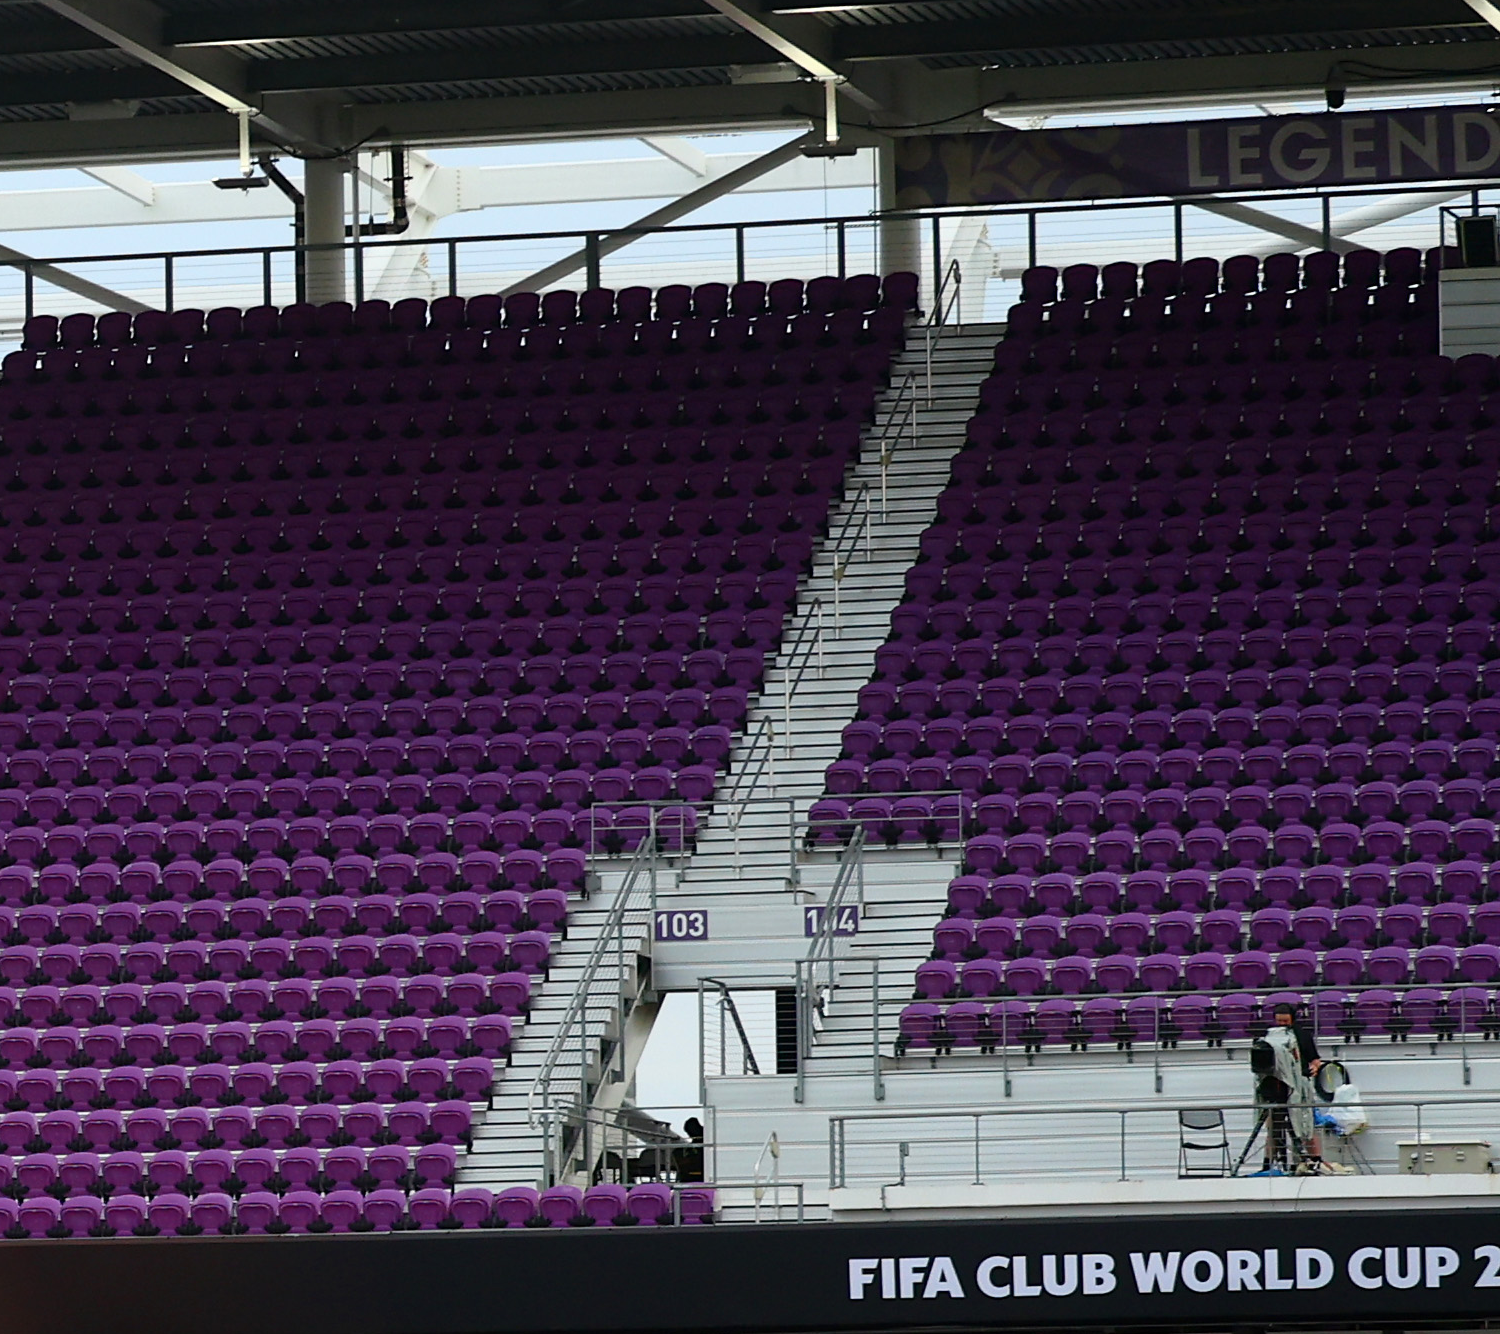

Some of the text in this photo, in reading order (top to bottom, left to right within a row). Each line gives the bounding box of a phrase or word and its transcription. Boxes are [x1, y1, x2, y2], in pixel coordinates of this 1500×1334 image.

[657, 913, 705, 938] 103
[848, 1257, 965, 1300] FIFA
[975, 1252, 1116, 1297] CLUB
[1129, 1248, 1334, 1294] WORLD
[1347, 1246, 1460, 1289] CUP
